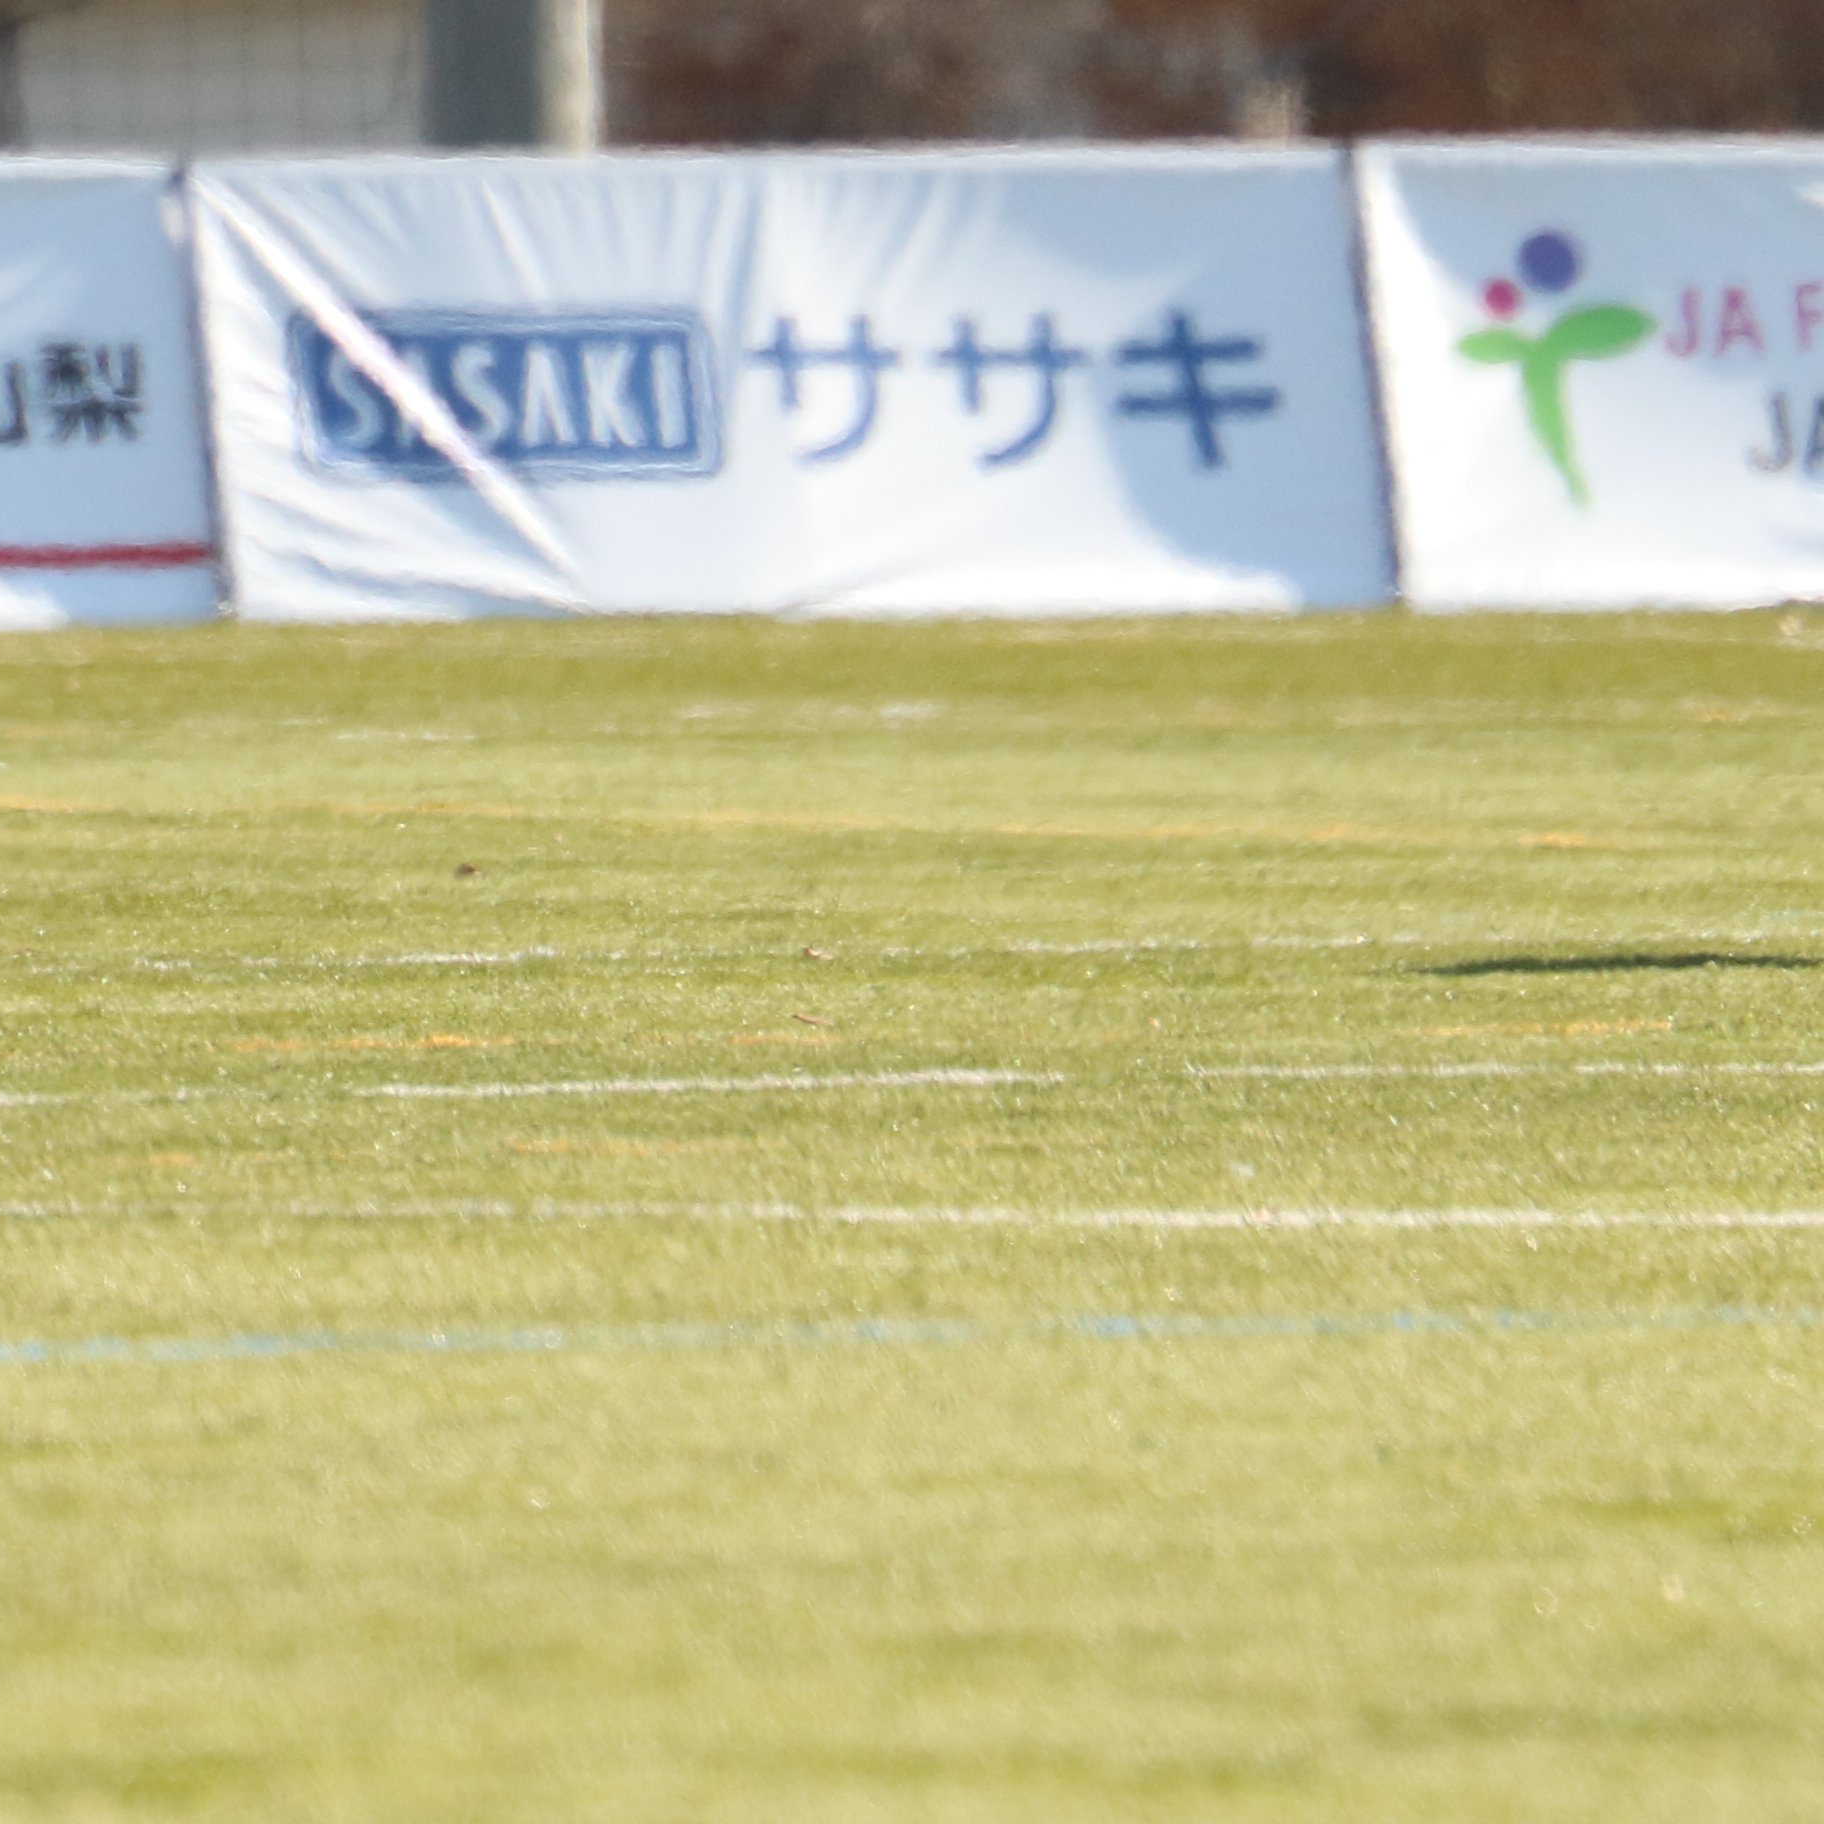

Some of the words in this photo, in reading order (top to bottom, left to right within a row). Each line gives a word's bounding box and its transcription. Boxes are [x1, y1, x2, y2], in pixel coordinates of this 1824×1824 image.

[1662, 284, 1766, 360] JA
[754, 314, 1280, 469] ササキ
